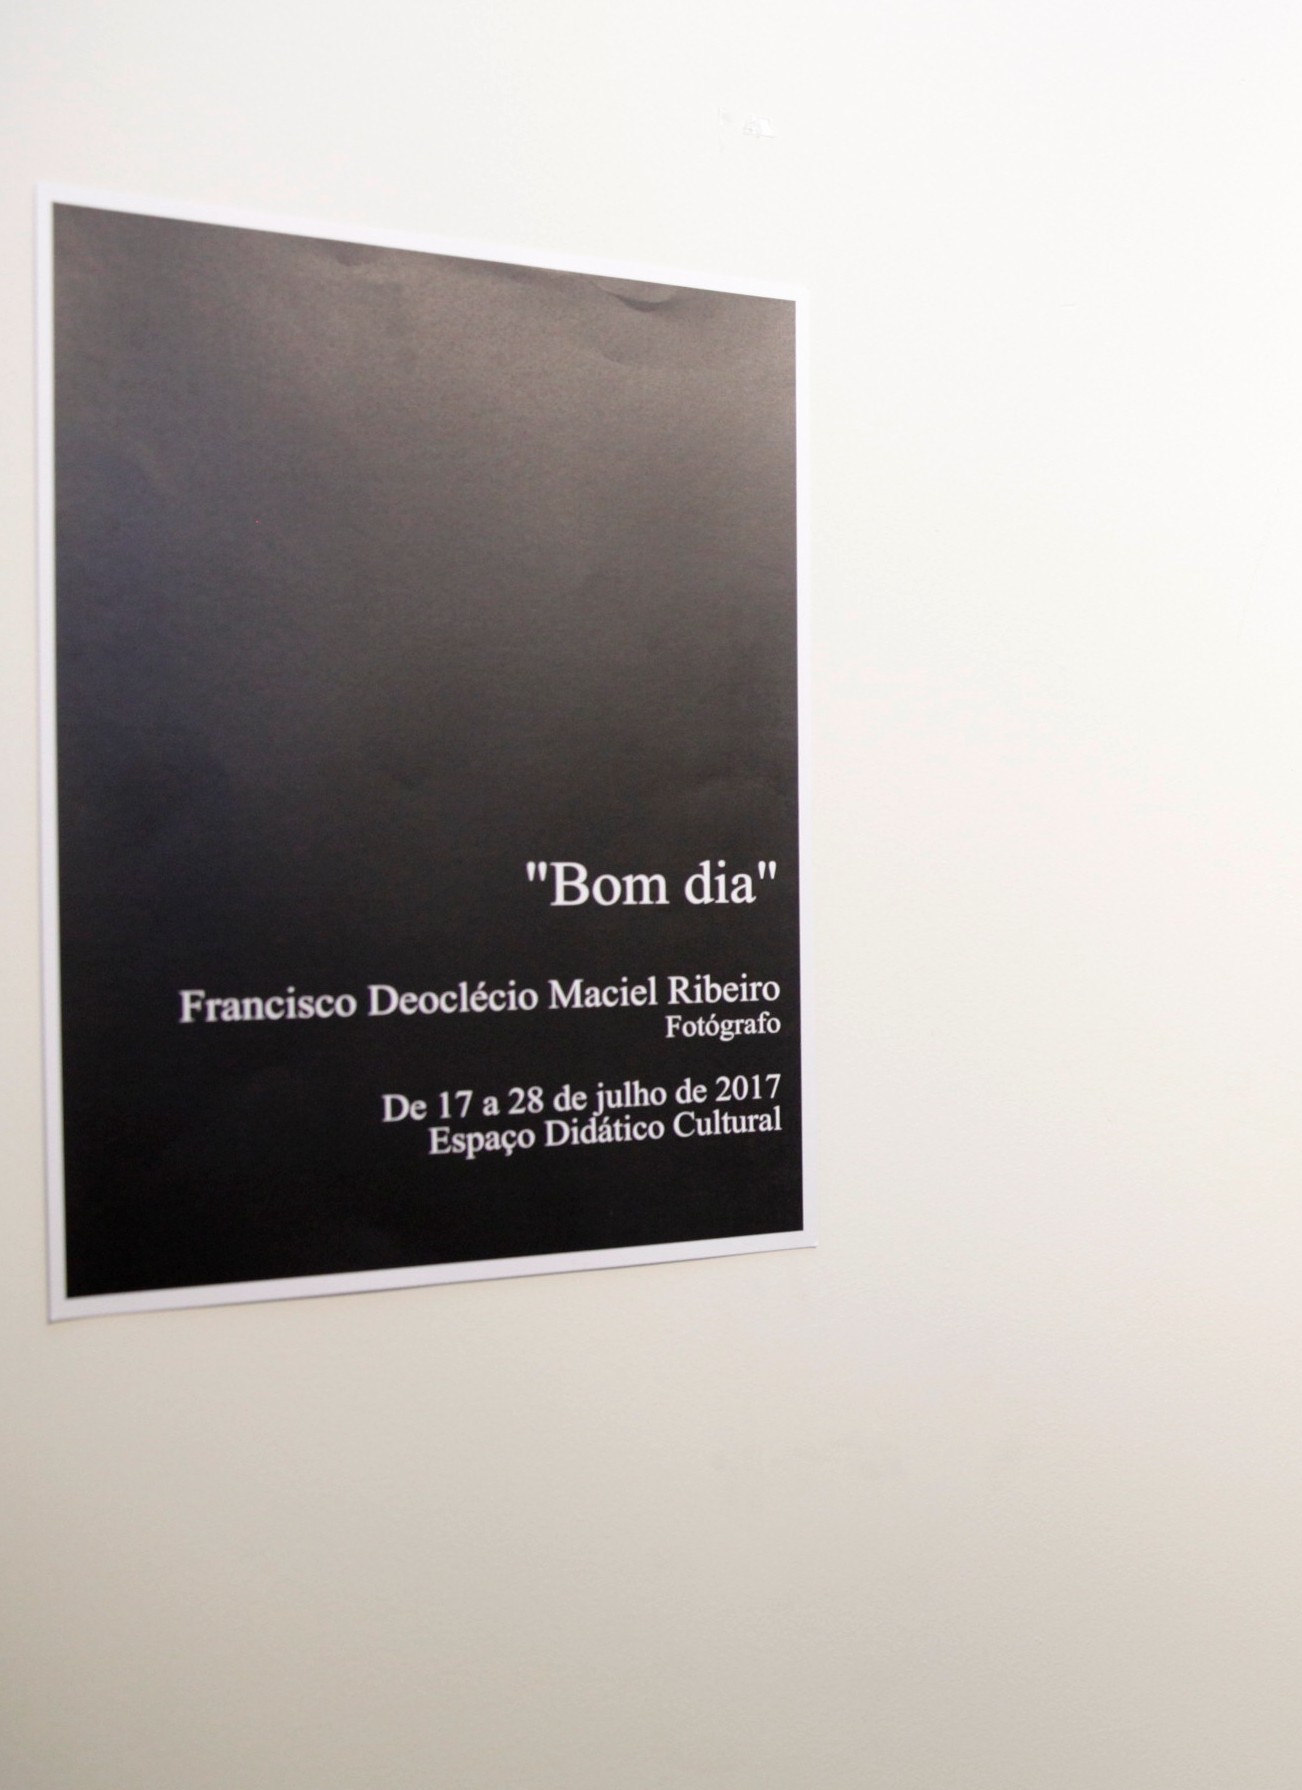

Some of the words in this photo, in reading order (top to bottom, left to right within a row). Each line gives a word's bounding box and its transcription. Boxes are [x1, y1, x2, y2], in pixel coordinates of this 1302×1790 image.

[526, 860, 670, 907] "Bom
[684, 859, 777, 905] dia"
[179, 986, 358, 1023] Francisco
[367, 979, 539, 1016] Deoclécio
[548, 975, 659, 1010] Maciel
[667, 972, 781, 1005] Ribeiro
[665, 1010, 782, 1042] Fotógrafo
[381, 1093, 427, 1123] De
[440, 1089, 473, 1119] 17
[482, 1096, 501, 1117] a
[508, 1085, 544, 1115] 28
[552, 1083, 588, 1112] de
[592, 1079, 668, 1115] julho
[674, 1077, 708, 1105] de
[715, 1073, 782, 1102] 2017
[428, 1126, 536, 1160] Espaço
[544, 1114, 665, 1147] Didático
[672, 1104, 783, 1138] Cultural
